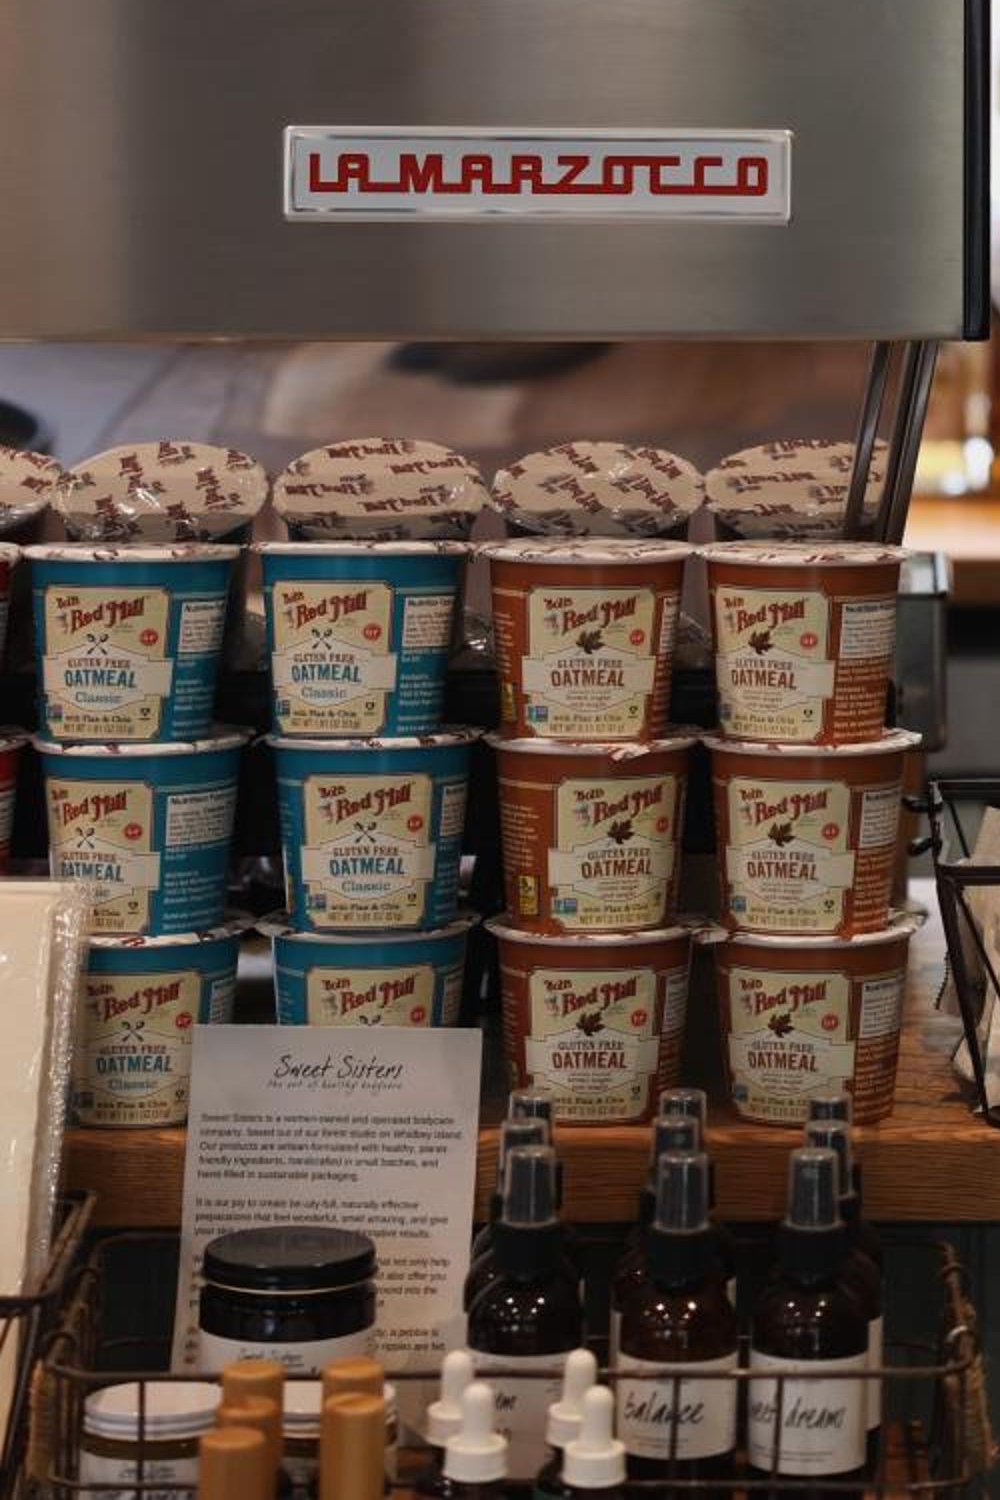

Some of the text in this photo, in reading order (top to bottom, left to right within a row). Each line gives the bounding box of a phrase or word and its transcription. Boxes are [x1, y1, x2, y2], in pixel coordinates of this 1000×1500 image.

[309, 153, 768, 197] LA MARZOCCO
[71, 597, 144, 634] Red Mill
[296, 599, 326, 630] Red
[330, 591, 367, 622] Mill
[563, 596, 637, 636] Red Mill
[736, 604, 766, 634] Red
[768, 599, 805, 630] Mill
[68, 659, 130, 669] GLUTEN FREE
[293, 653, 355, 664] GLUTEN FREE
[558, 659, 623, 669] GLUTEN FREE
[735, 658, 793, 670] GLUTEN FREE
[64, 669, 137, 688] OATMEAL
[291, 663, 362, 682] OATMEAL
[551, 670, 624, 687] OATMEAL
[731, 669, 799, 689] OATMEAL
[75, 692, 122, 703] Classic
[302, 687, 346, 698] Classic
[62, 789, 128, 826] Red Mill
[335, 783, 412, 825] Red Mill
[592, 784, 662, 826] Red Mill
[755, 798, 788, 826] Red
[790, 790, 828, 821] Mill
[92, 852, 117, 863] FREE
[333, 846, 399, 857] GLUTEN FREE
[587, 847, 650, 860] GLUTEN FREE
[751, 851, 815, 862] GLUTEN FREE
[329, 858, 404, 876] OATMEAL
[581, 858, 652, 879] OATMEAL
[747, 861, 819, 880] OATMEAL
[341, 881, 391, 893] Classic
[103, 982, 180, 1023] Red Mill
[340, 974, 416, 1016] Red Mill
[561, 977, 637, 1017] Red Mill
[754, 986, 787, 1016] Red
[788, 980, 828, 1013] Mill
[99, 1045, 167, 1055] GLUTEN FREE
[558, 1041, 625, 1051] GLUTEN FREE
[752, 1040, 815, 1053] GLUTEN FREE
[96, 1056, 173, 1074] OATMEAL
[273, 1054, 403, 1079] Sweet Sisters
[551, 1051, 628, 1069] OATMEAL
[748, 1051, 818, 1073] OATMEAL
[108, 1078, 158, 1091] Classic
[200, 1141, 217, 1151] Our
[219, 1142, 257, 1153] products
